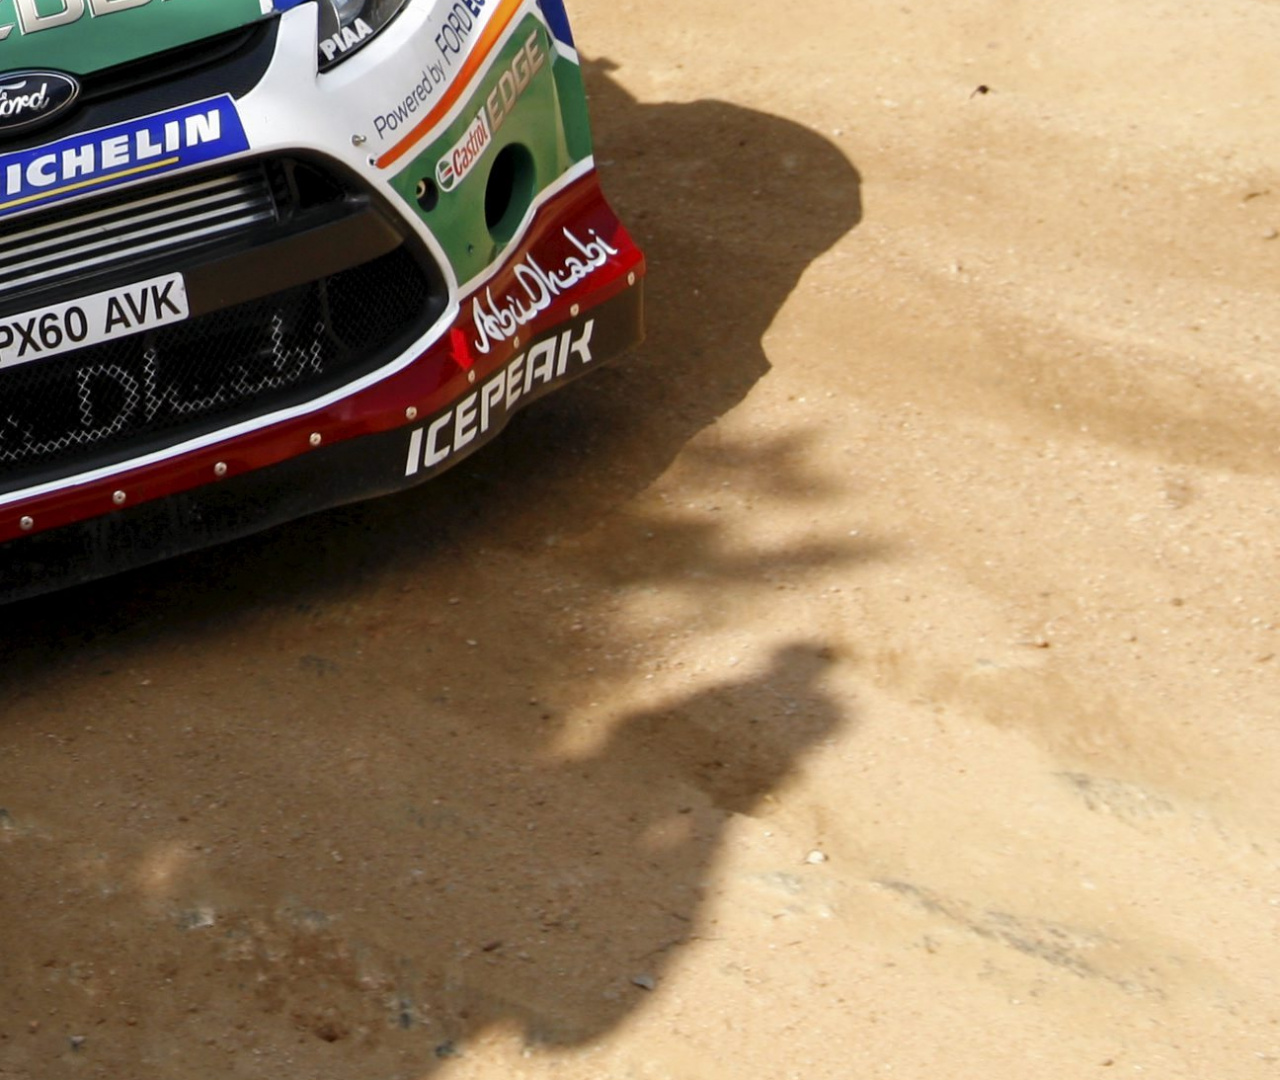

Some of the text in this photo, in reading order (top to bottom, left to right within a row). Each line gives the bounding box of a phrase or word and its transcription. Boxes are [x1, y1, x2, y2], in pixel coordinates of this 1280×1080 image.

[319, 18, 373, 61] PIAA
[435, 2, 473, 65] FORD
[428, 60, 448, 85] by
[452, 29, 544, 177] Castrol EDGE
[373, 75, 434, 139] Powered
[103, 280, 182, 335] AVK
[405, 318, 595, 477] ICEPEAK
